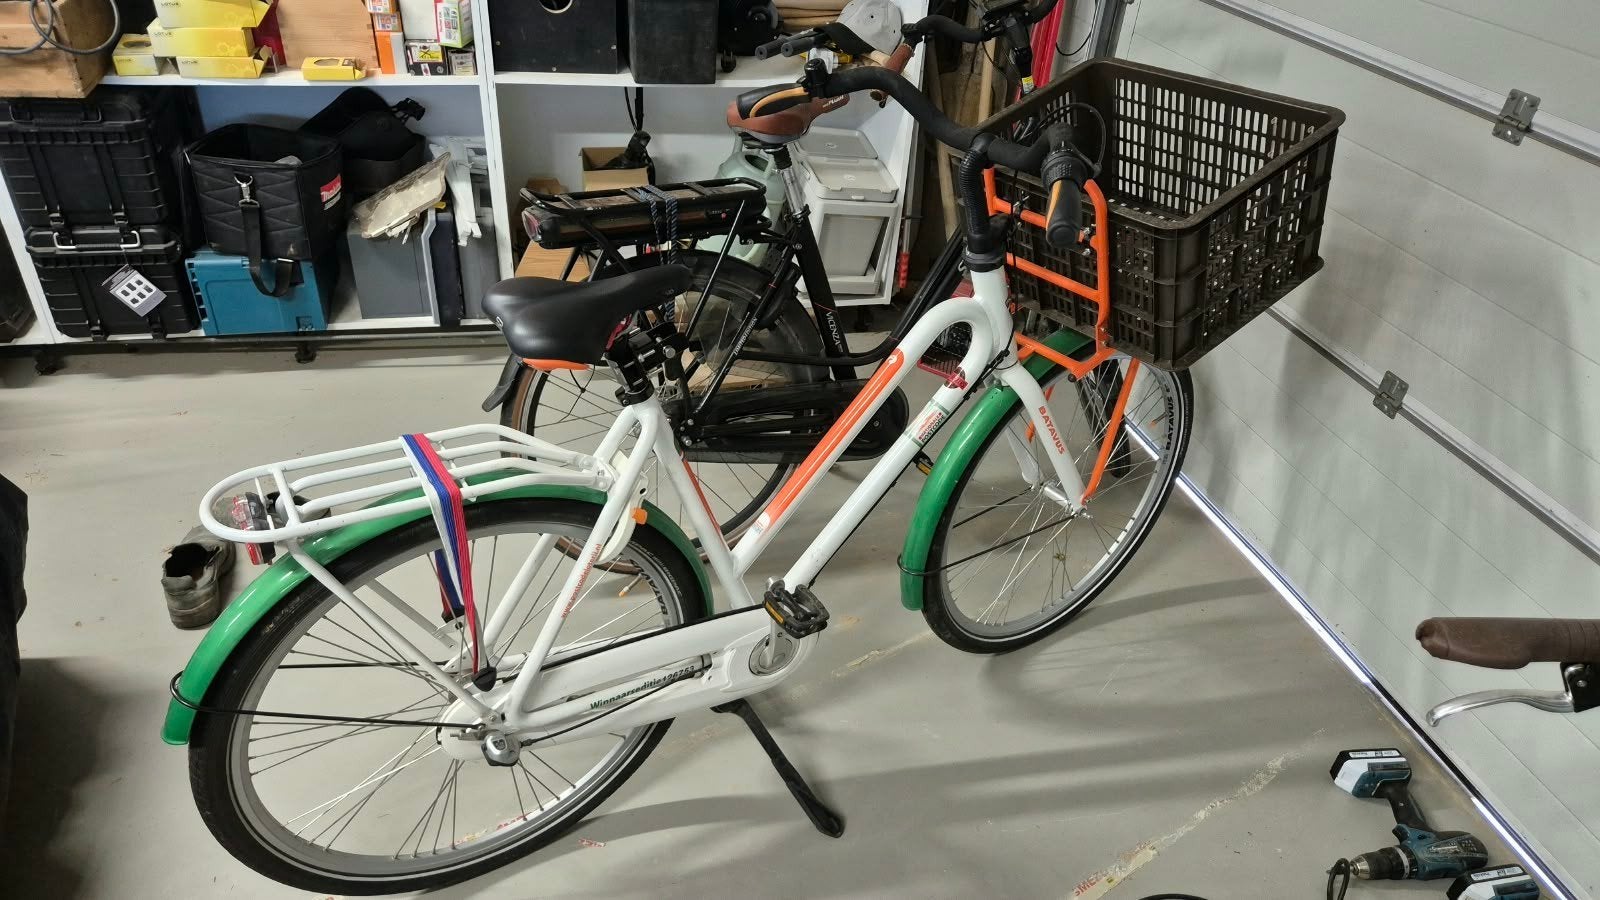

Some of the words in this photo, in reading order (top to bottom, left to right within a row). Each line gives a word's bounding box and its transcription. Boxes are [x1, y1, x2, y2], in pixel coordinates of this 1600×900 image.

[825, 311, 841, 346] VICENZA
[1038, 405, 1066, 455] BATAVUS
[1165, 396, 1175, 451] BATAVUS
